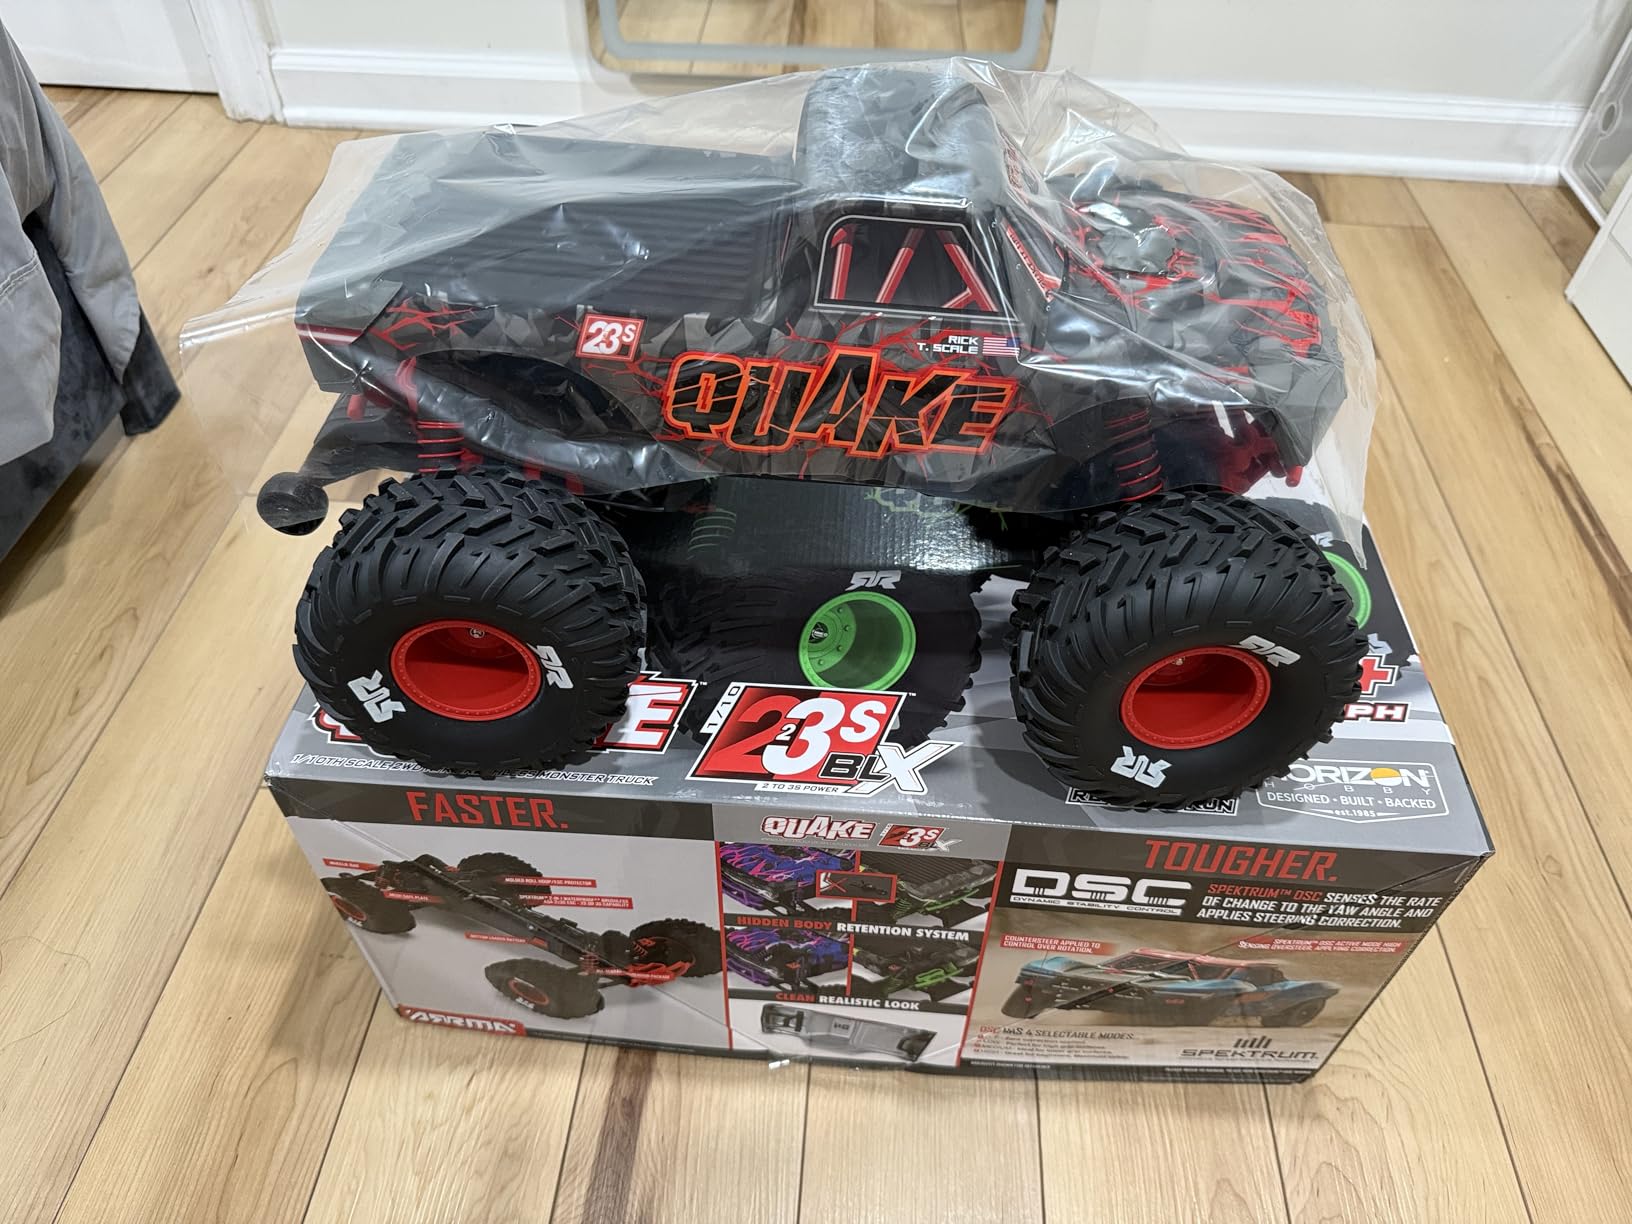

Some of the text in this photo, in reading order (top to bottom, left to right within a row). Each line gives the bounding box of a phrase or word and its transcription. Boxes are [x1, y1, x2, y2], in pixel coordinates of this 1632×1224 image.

[916, 342, 979, 355] T. SCALE
[947, 335, 979, 346] RICK
[662, 347, 1019, 459] QUAKE
[1344, 703, 1406, 720] PH
[290, 753, 345, 767] 1/10TH
[344, 757, 391, 771] SCALE
[536, 769, 605, 783] MONSTER
[606, 774, 660, 787] TRUCK
[1280, 763, 1432, 788] ORIZON
[803, 785, 839, 794] POWER
[1266, 791, 1437, 809] DESIGNED BUILT BACKED
[404, 790, 570, 831] FASTER.
[761, 814, 877, 841] QUAKE
[1143, 838, 1339, 884] TOUGHER.
[1011, 868, 1193, 907] DSC
[1013, 896, 1181, 915] DYNAMIC STABILITY CONTROL
[1201, 895, 1434, 919] OF CHANGE TO THE YAW ANGLE AND
[1293, 890, 1323, 902] DSC
[1323, 891, 1379, 906] SENSES
[1380, 895, 1407, 907] THE
[1408, 896, 1443, 908] RATE
[1196, 908, 1403, 929] APPLIES STEERING CORRECTION.
[736, 915, 970, 942] HIDDEN BODY RETENTION SYSTEM
[1003, 940, 1037, 950] CONTROL
[1036, 943, 1056, 951] OVER
[1004, 934, 1101, 950] COUNTERSTEER APPLIED TO
[775, 991, 921, 1011] CLEAN REALISTIC LOOK
[1034, 1029, 1097, 1040] SELECTABLE
